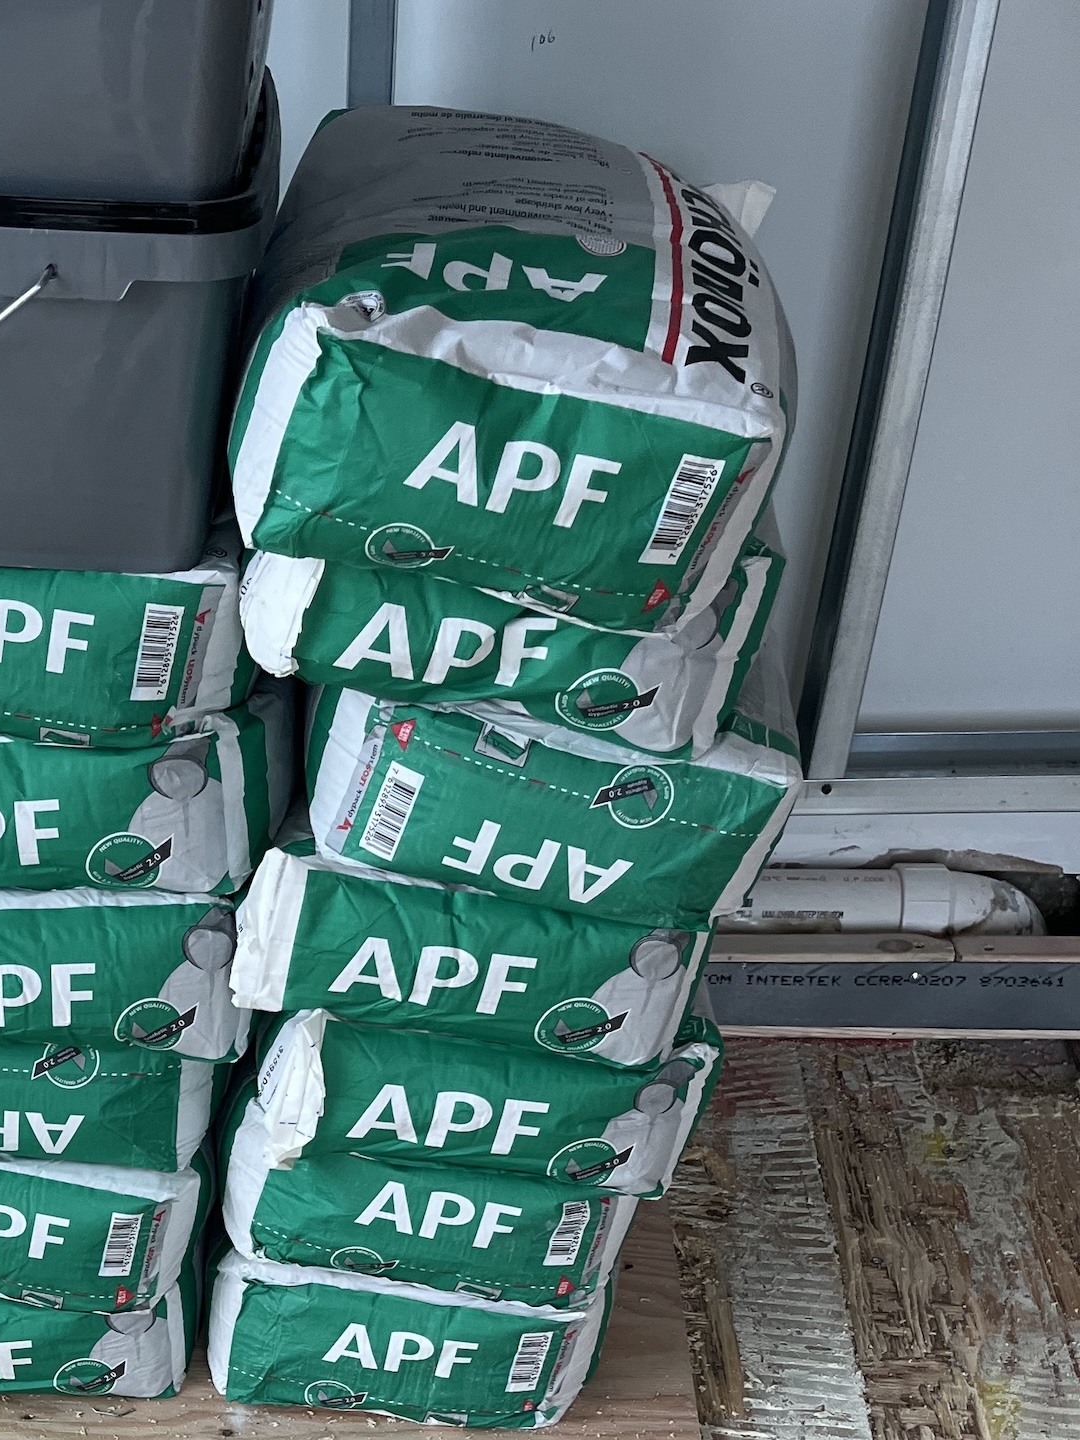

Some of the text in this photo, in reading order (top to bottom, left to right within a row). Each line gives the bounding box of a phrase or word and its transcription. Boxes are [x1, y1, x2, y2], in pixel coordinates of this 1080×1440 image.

[514, 198, 608, 217] very low shrinkage
[403, 421, 622, 528] APF
[676, 512, 699, 549] 612895
[695, 468, 719, 509] 317526
[159, 652, 172, 685] 612895
[167, 615, 180, 651] 317526
[333, 602, 558, 688] APF
[582, 674, 631, 689] NEW QUALITY!
[622, 699, 640, 710] 2.0
[377, 778, 394, 812] 612895
[608, 788, 623, 798] 2.0
[347, 789, 363, 818] dypack
[364, 811, 382, 842] 317526
[98, 837, 144, 853] NEW QUALITY!
[145, 853, 162, 867] 2.0
[442, 820, 633, 903] APF
[328, 937, 537, 1014] APF
[703, 974, 732, 985] OM
[746, 974, 842, 986] INTERTEK
[128, 1002, 171, 1017] NEW QUALITY!
[557, 1002, 601, 1014] NEW QUALITY!
[170, 1019, 186, 1032] 2.0
[596, 1023, 612, 1033] 2.0
[42, 1058, 56, 1069] 2.0
[346, 1084, 549, 1155] APF
[604, 1158, 620, 1169] 2.0
[354, 1181, 522, 1248] APF
[322, 1323, 479, 1378] APF
[103, 1371, 117, 1382] 2.0
